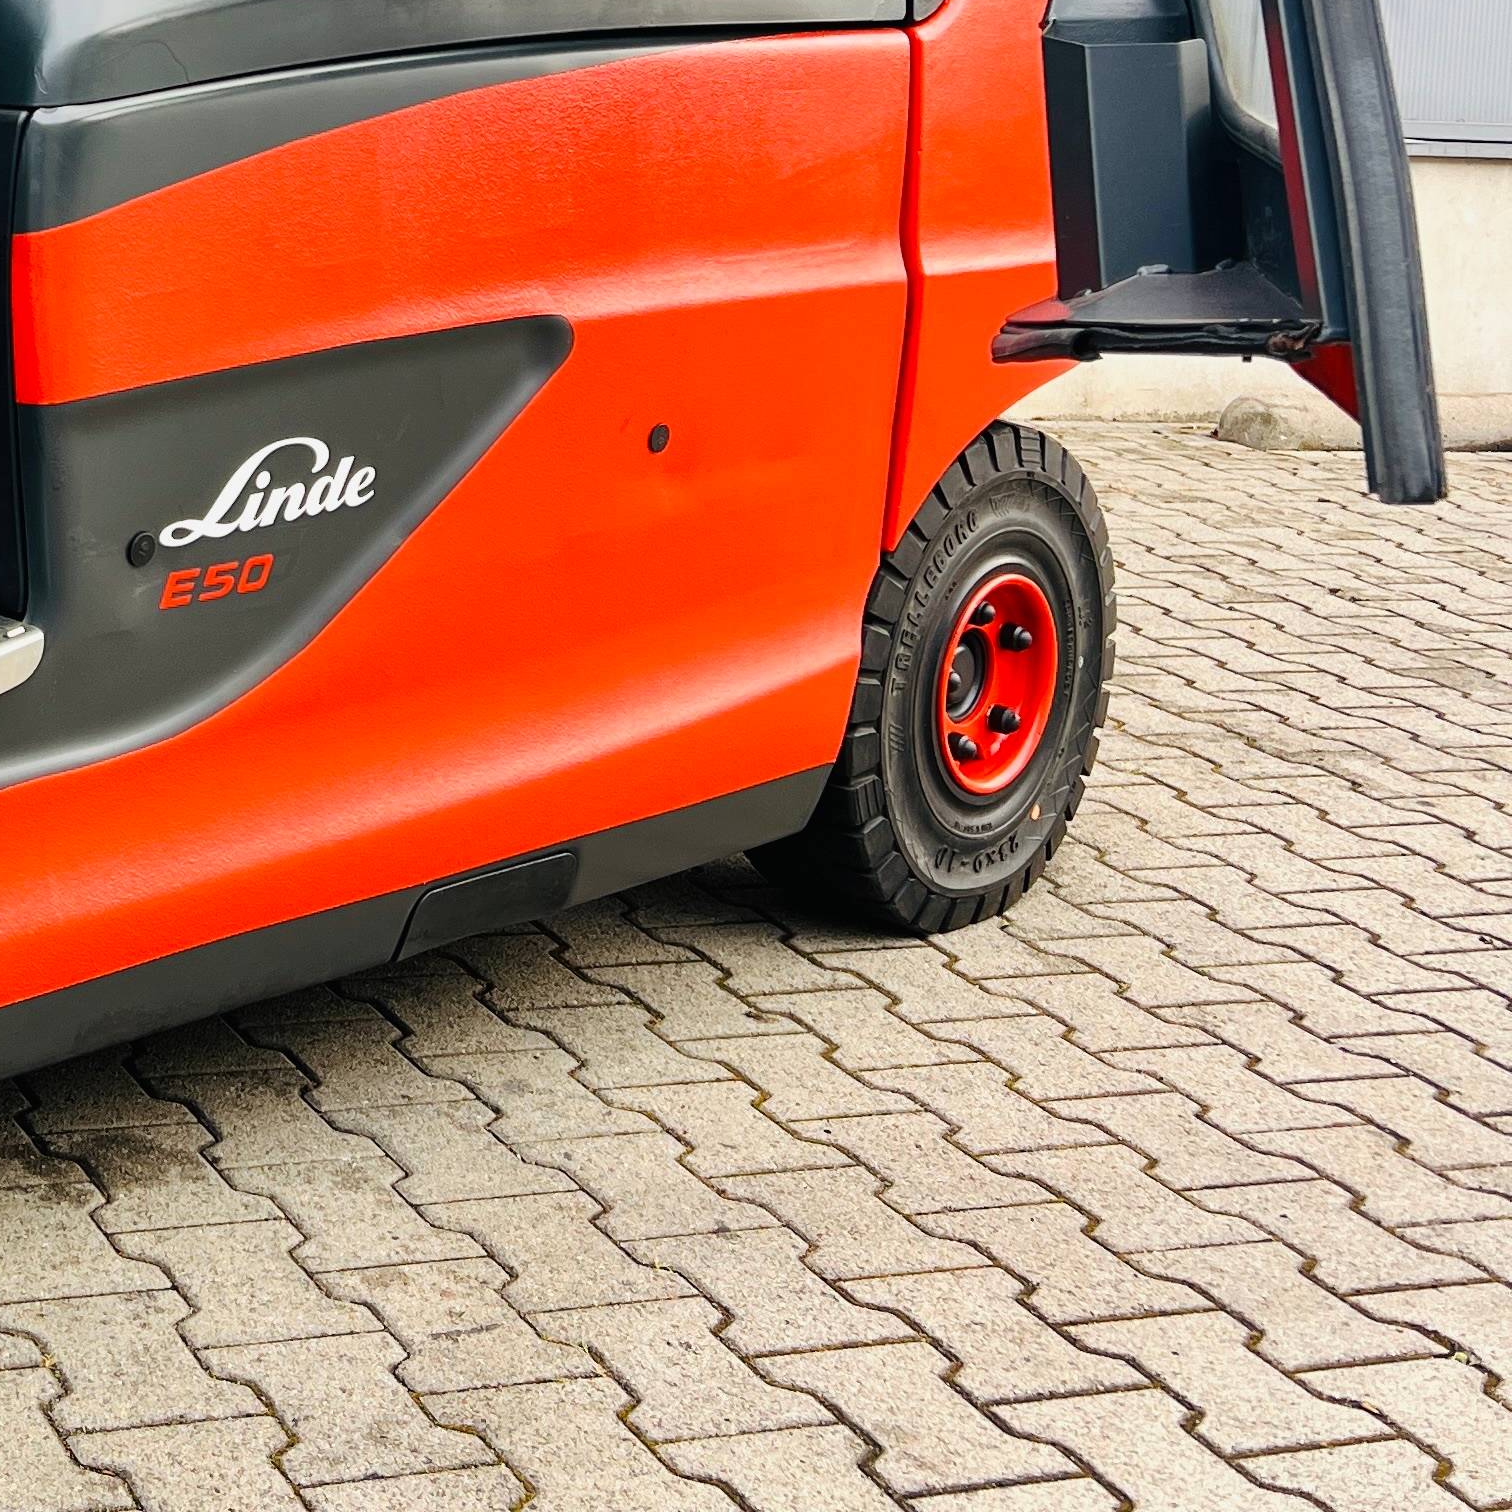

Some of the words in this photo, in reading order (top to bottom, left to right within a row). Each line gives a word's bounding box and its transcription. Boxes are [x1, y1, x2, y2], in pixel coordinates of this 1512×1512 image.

[158, 437, 377, 548] Linde
[159, 554, 274, 610] E50
[890, 508, 978, 696] TRELLEBORG
